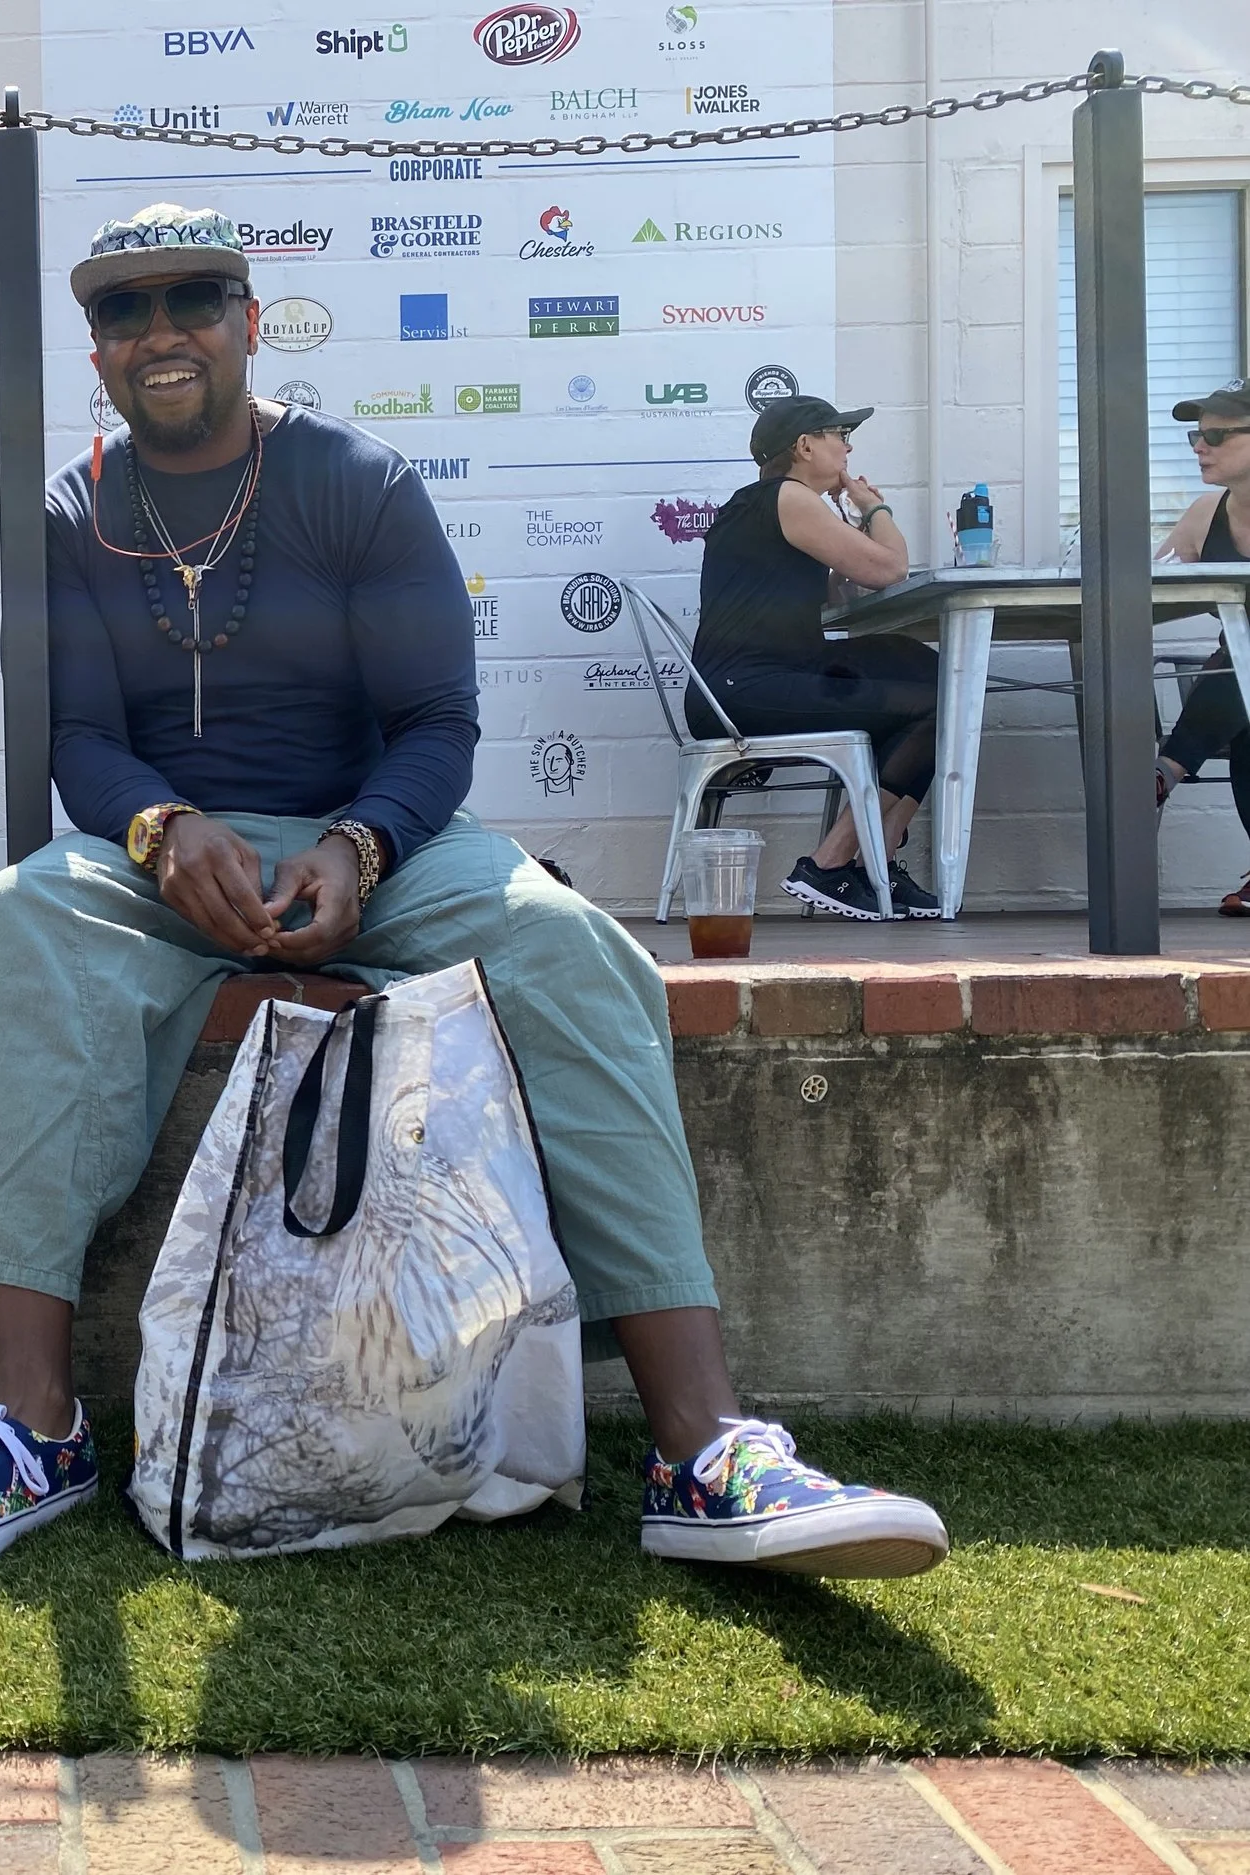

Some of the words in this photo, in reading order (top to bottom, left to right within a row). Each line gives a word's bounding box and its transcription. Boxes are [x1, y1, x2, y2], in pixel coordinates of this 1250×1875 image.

[513, 13, 542, 37] Dr
[164, 26, 255, 56] BBVA
[316, 28, 384, 60] Shipt
[488, 19, 560, 59] Pepper
[658, 40, 706, 51] SLOSS
[550, 87, 638, 111] BALCH
[693, 84, 748, 100] JONES
[299, 101, 349, 114] Warren
[385, 99, 454, 124] Bham
[459, 97, 514, 121] Now
[694, 99, 761, 115] WALKER
[150, 104, 220, 129] Uniti
[295, 113, 349, 126] Averett
[562, 112, 616, 121] BINGHAM
[390, 158, 483, 182] CORPORATE
[371, 214, 483, 232] BRASFIELD
[238, 219, 334, 252] Bradley
[370, 233, 399, 259] &
[400, 231, 481, 248] GORRIE
[519, 239, 595, 260] Chester's
[533, 300, 616, 313] STEWART
[534, 321, 616, 335] PERRY
[371, 389, 417, 401] COMMUNITY
[485, 387, 518, 395] FARMERS
[645, 383, 709, 404] UAB
[354, 395, 434, 416] foodbank
[485, 402, 518, 410] COALITION
[640, 410, 714, 418] SUSTAINABILITY
[526, 510, 554, 522] THE
[675, 513, 693, 529] The
[693, 512, 715, 529] COLL
[445, 523, 482, 538] EID
[527, 521, 604, 535] BLUEROOT
[526, 534, 604, 547] COMPANY
[562, 575, 589, 605] BRANDING
[590, 574, 620, 604] SOLUTIONS
[474, 619, 499, 636] CLE
[479, 669, 543, 684] RITUS
[558, 730, 564, 739] A
[531, 736, 547, 757] SON
[566, 733, 587, 776] BUTCHER
[530, 760, 540, 778] THE
